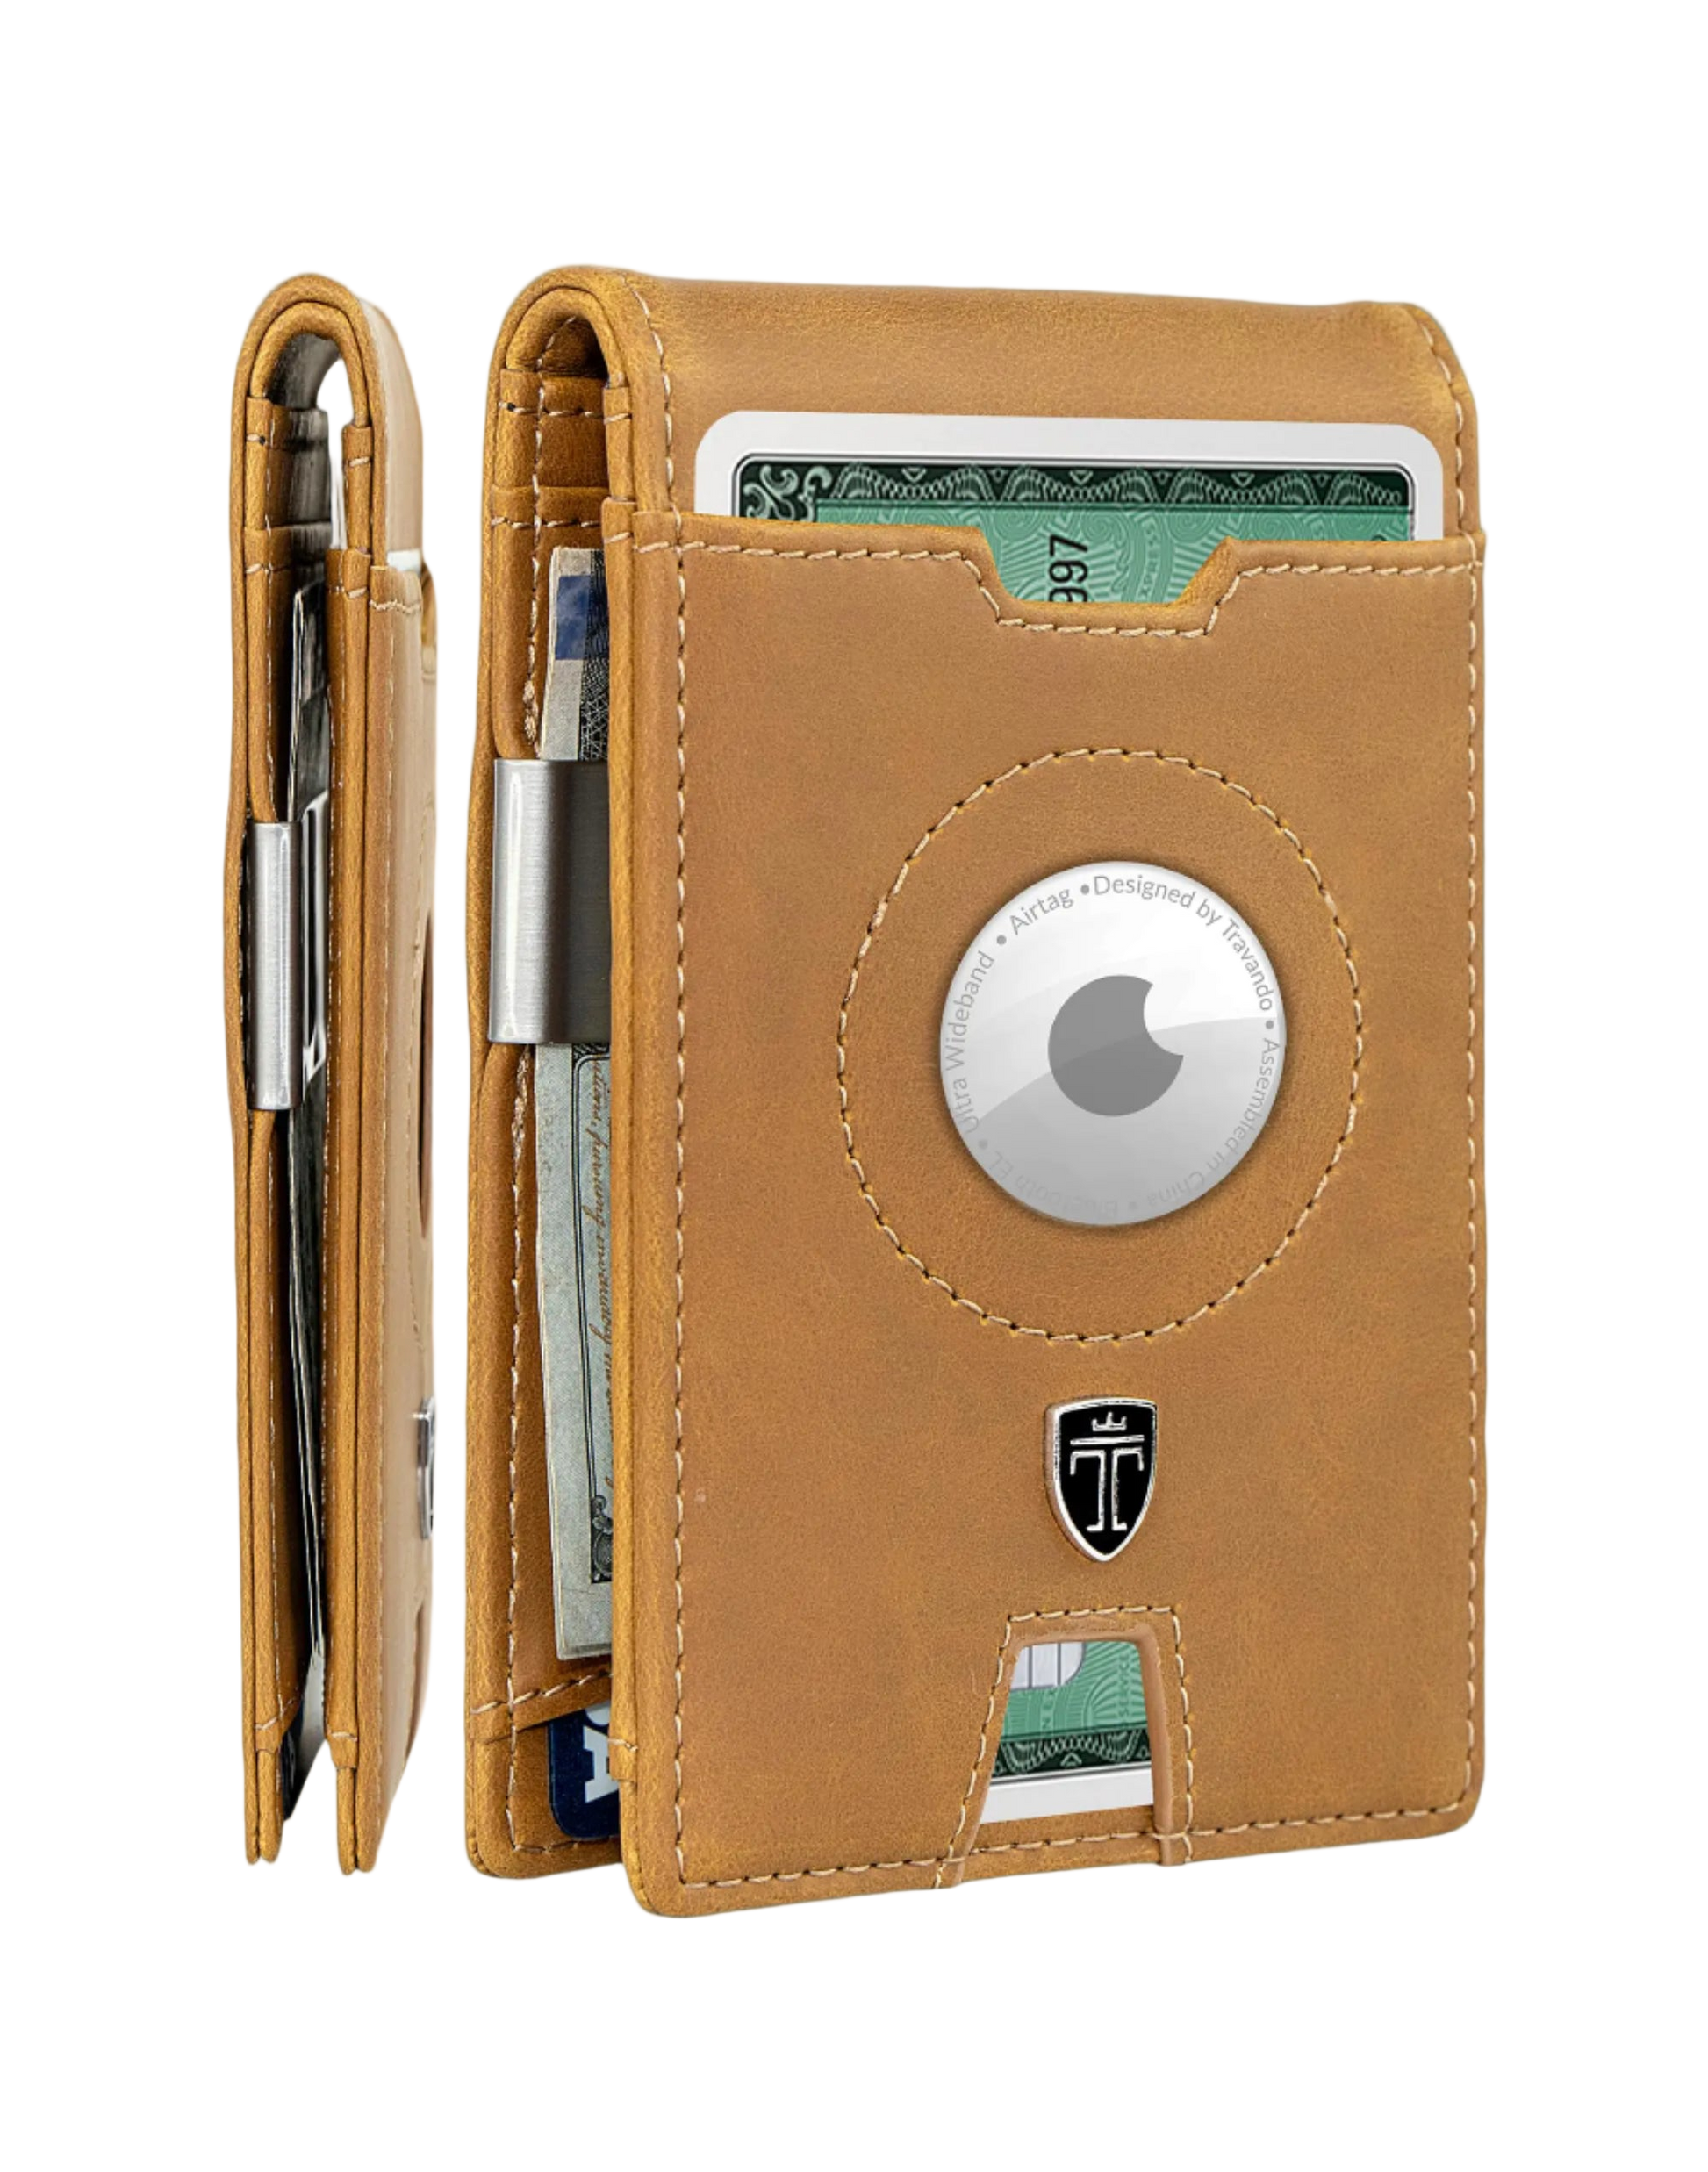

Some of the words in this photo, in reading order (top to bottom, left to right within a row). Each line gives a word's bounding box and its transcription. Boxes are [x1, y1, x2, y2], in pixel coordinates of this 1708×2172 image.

[1008, 887, 1074, 935] Airtag
[1094, 875, 1195, 907] Designed
[1195, 898, 1222, 926] by
[1221, 918, 1273, 1011] Travando
[946, 952, 994, 1072] Wideband
[951, 1078, 980, 1133] Ultra
[1225, 1037, 1280, 1153] Assembled
[1207, 1150, 1226, 1172] in
[1146, 1171, 1204, 1206] China
